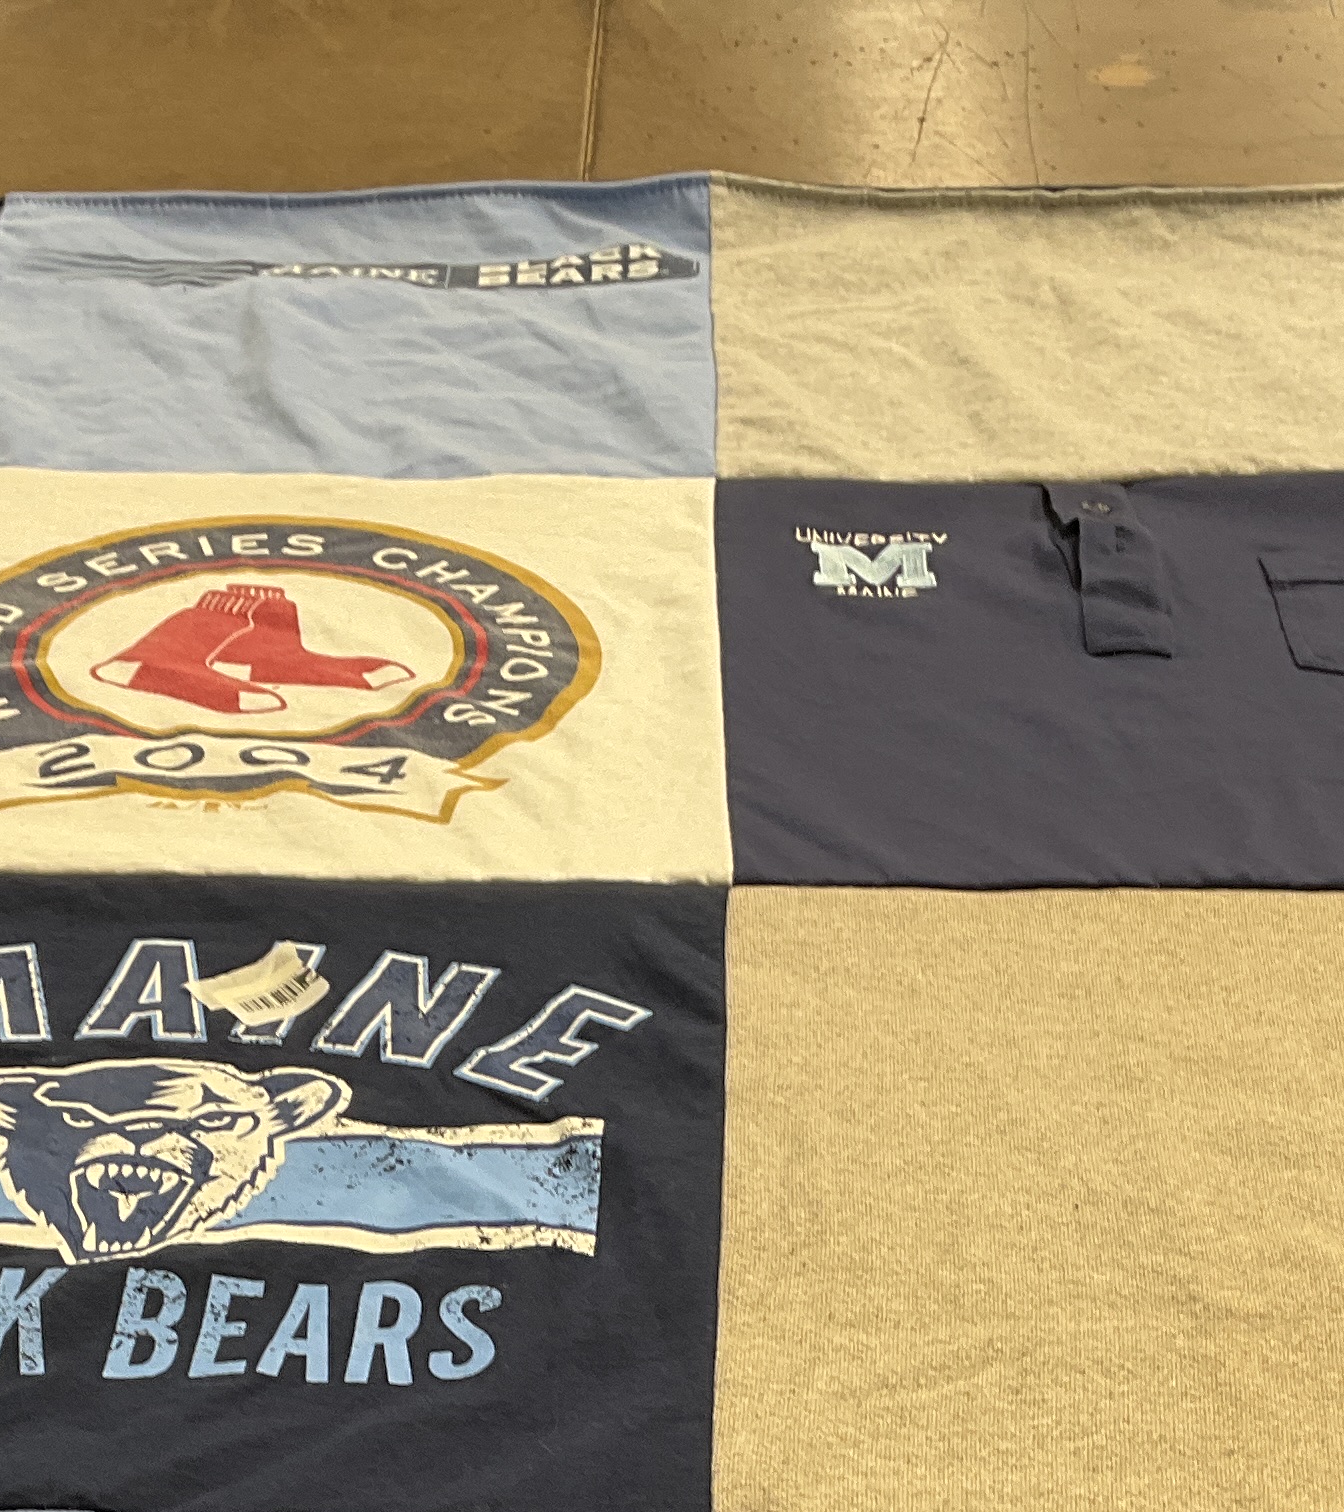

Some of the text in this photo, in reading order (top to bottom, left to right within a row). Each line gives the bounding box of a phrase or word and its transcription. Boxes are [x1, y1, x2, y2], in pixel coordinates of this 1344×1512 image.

[37, 532, 324, 596] SERIES
[371, 546, 553, 728] CHAMPIONS
[35, 741, 409, 787] 2004
[102, 1266, 502, 1384] BEARS
